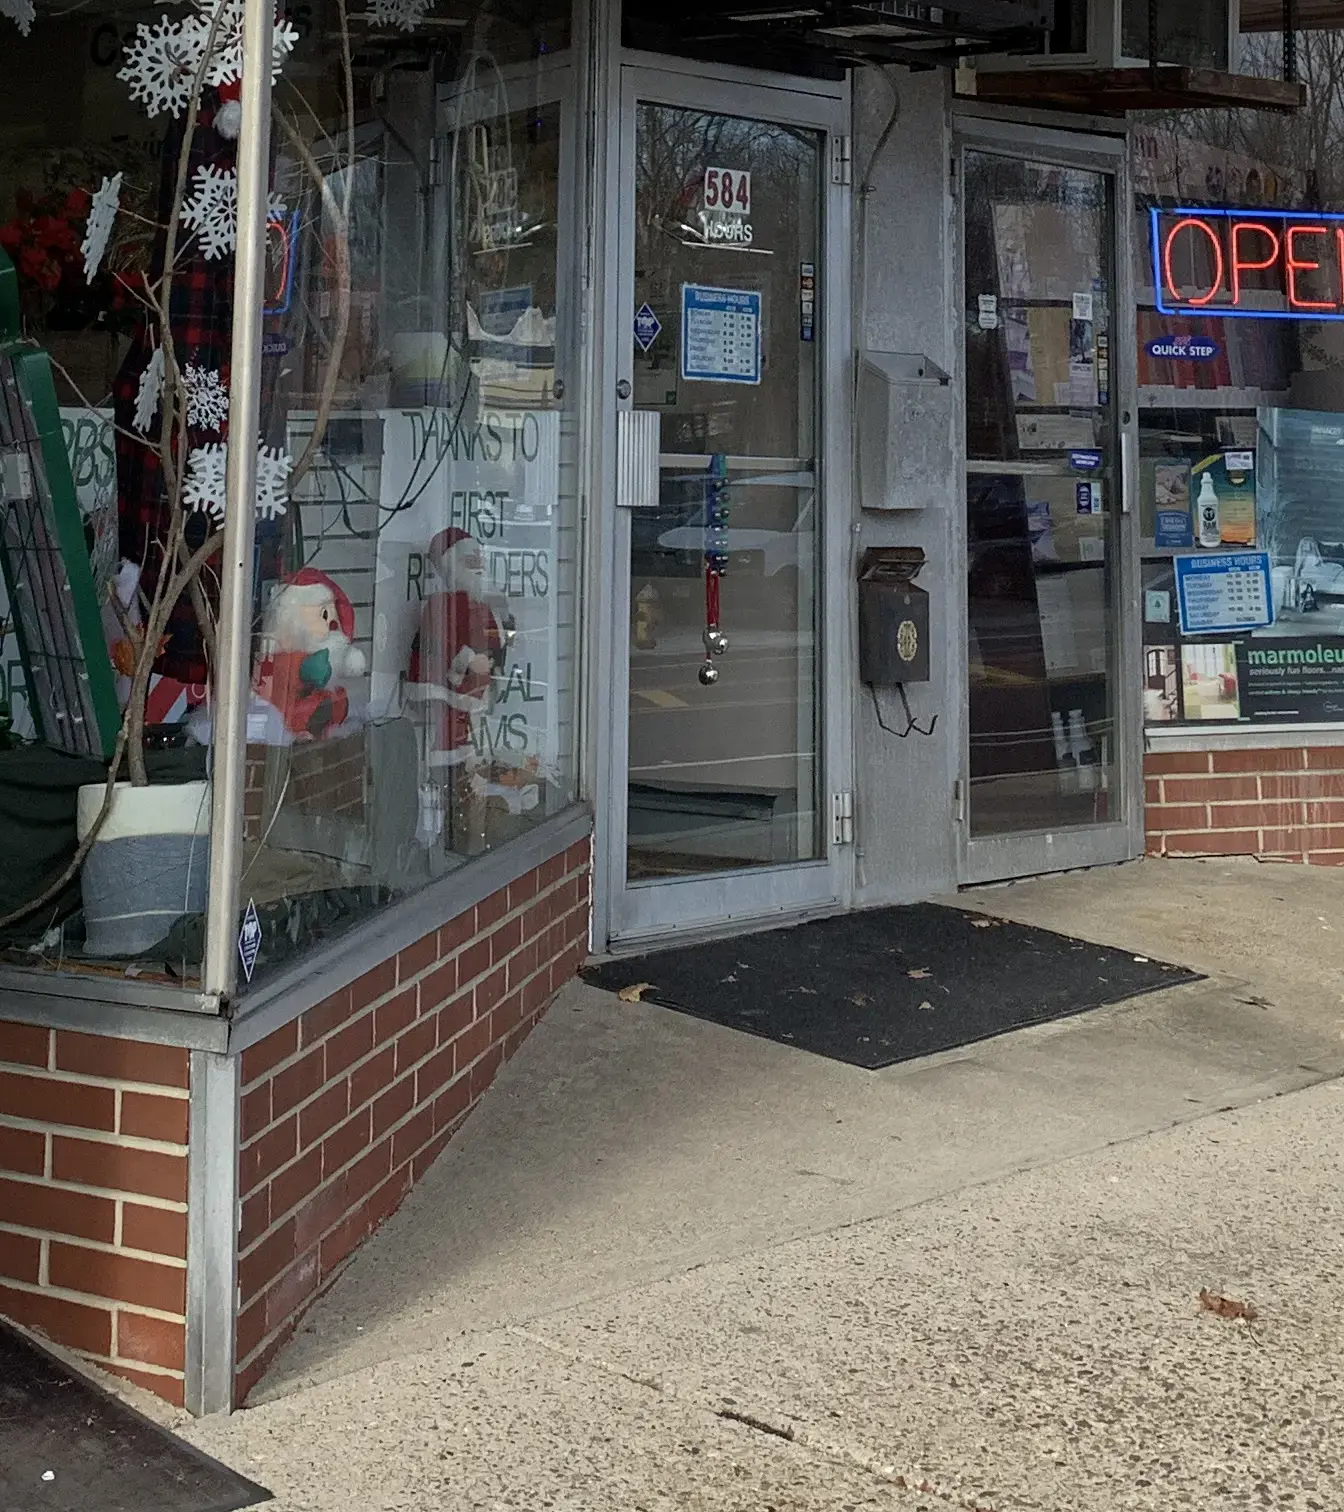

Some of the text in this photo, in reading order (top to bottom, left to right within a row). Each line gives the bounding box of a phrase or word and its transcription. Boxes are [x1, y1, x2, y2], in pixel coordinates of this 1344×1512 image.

[706, 170, 749, 210] 584
[706, 221, 753, 242] HOURS
[1152, 344, 1213, 356] QUICK STEP
[402, 411, 540, 463] THANKS TO
[450, 491, 509, 538] FIRST
[407, 551, 549, 601] REDERS
[1191, 555, 1262, 568] BUSINESS HOURS
[1249, 666, 1286, 676] seriously
[1287, 665, 1300, 674] fun
